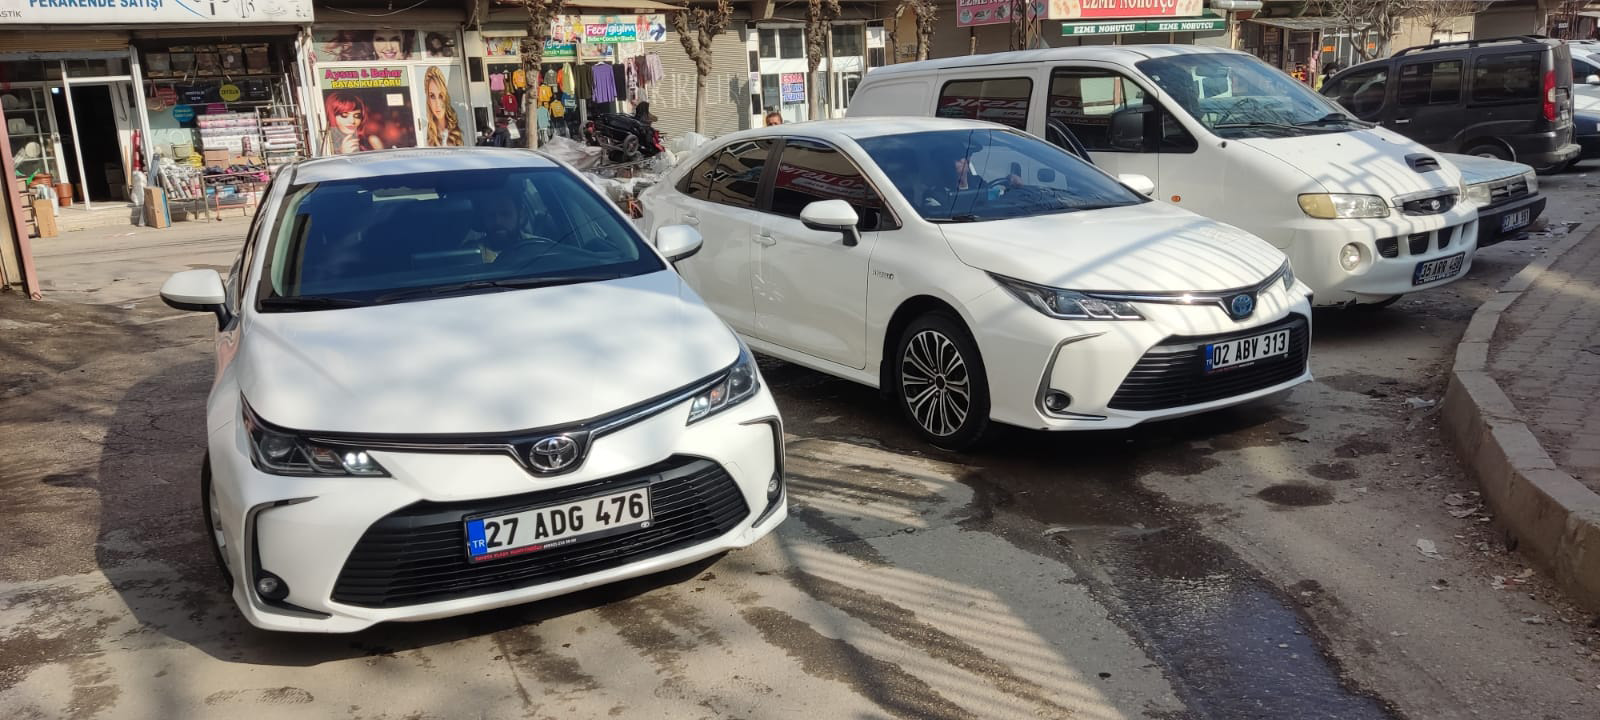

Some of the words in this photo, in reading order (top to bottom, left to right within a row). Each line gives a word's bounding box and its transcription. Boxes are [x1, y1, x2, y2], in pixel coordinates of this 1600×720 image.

[1213, 344, 1229, 366] 02
[1235, 338, 1259, 361] ABV
[1262, 332, 1286, 355] 313
[485, 517, 519, 549] 27
[534, 506, 584, 540] ADG
[595, 493, 644, 526] 476
[472, 540, 485, 548] TR
